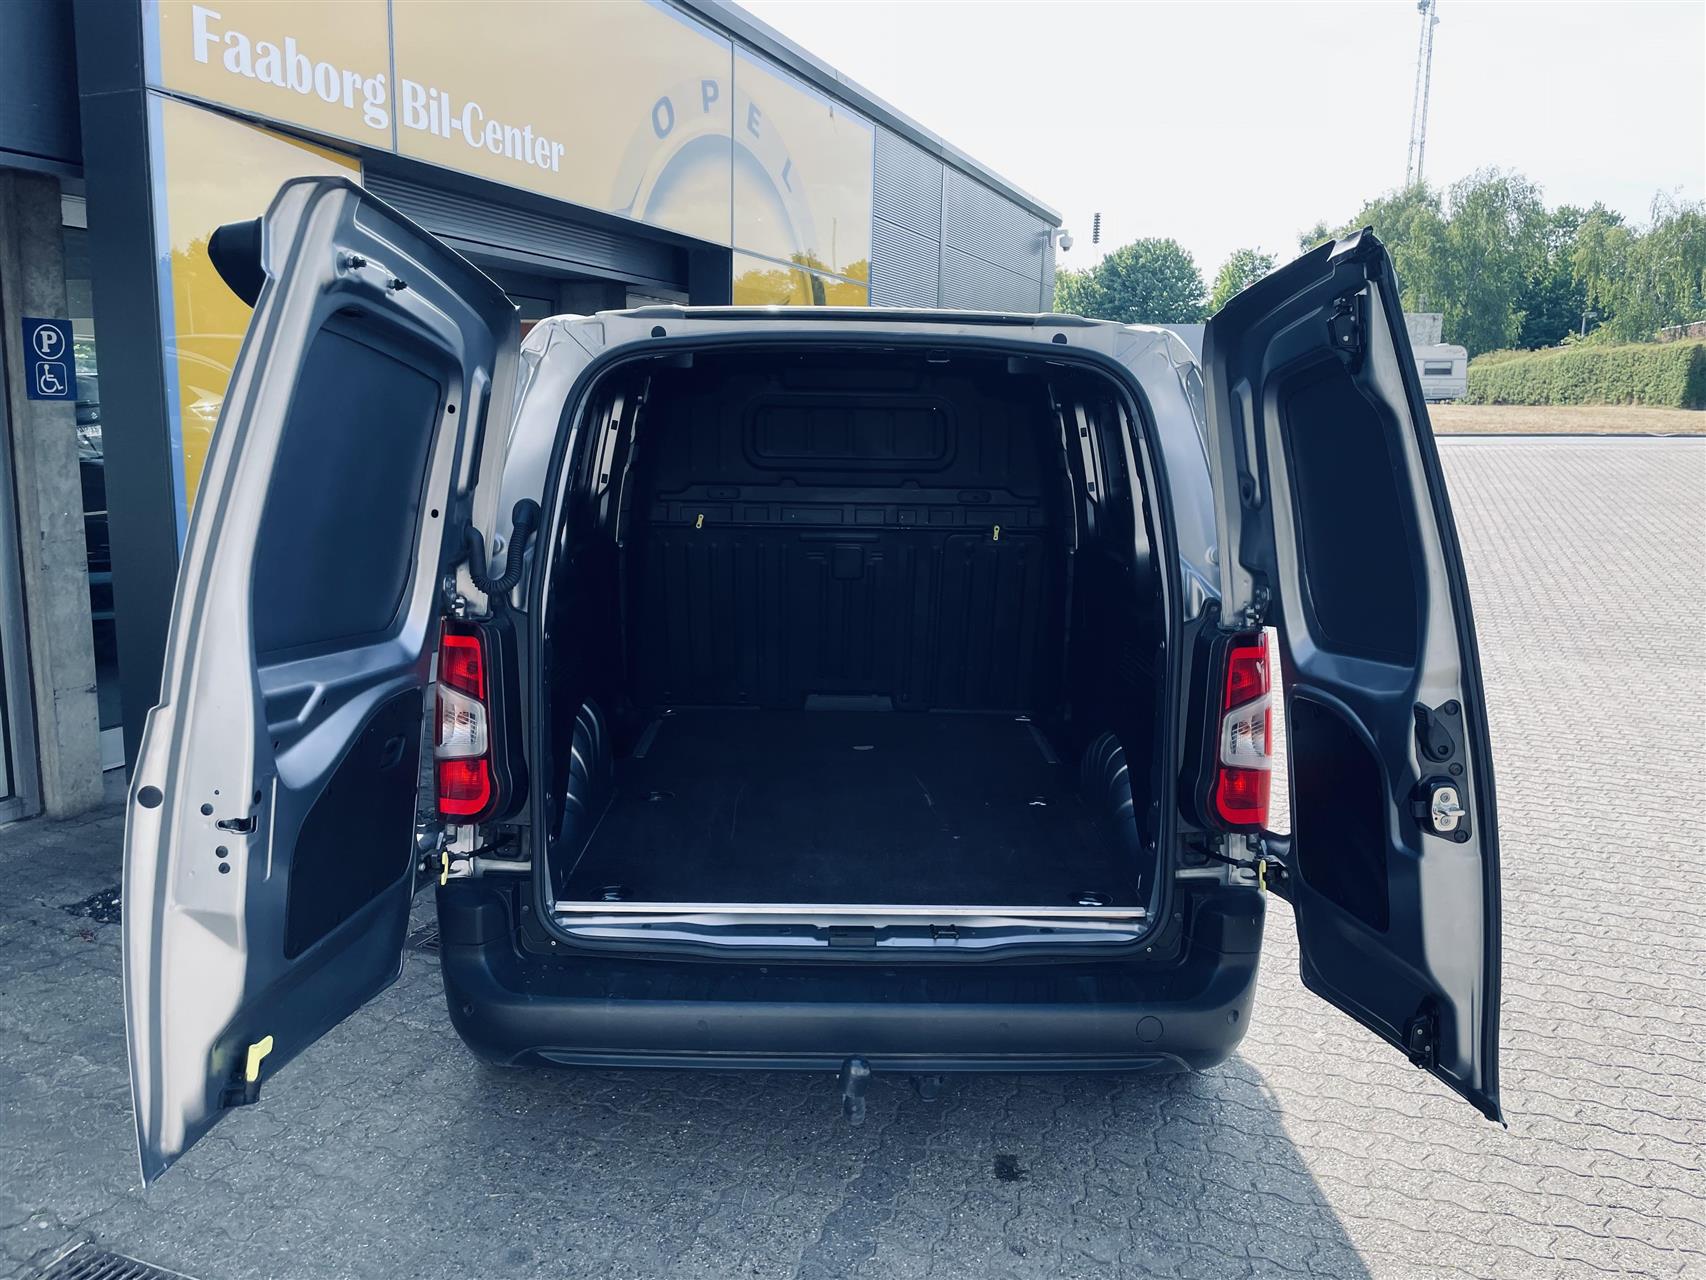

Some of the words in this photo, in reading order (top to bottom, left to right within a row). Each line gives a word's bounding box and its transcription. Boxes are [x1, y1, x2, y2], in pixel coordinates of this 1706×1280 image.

[192, 4, 389, 130] Faaborg
[401, 79, 565, 172] Bil-Center
[651, 79, 793, 193] OPEL
[40, 330, 57, 352] P
